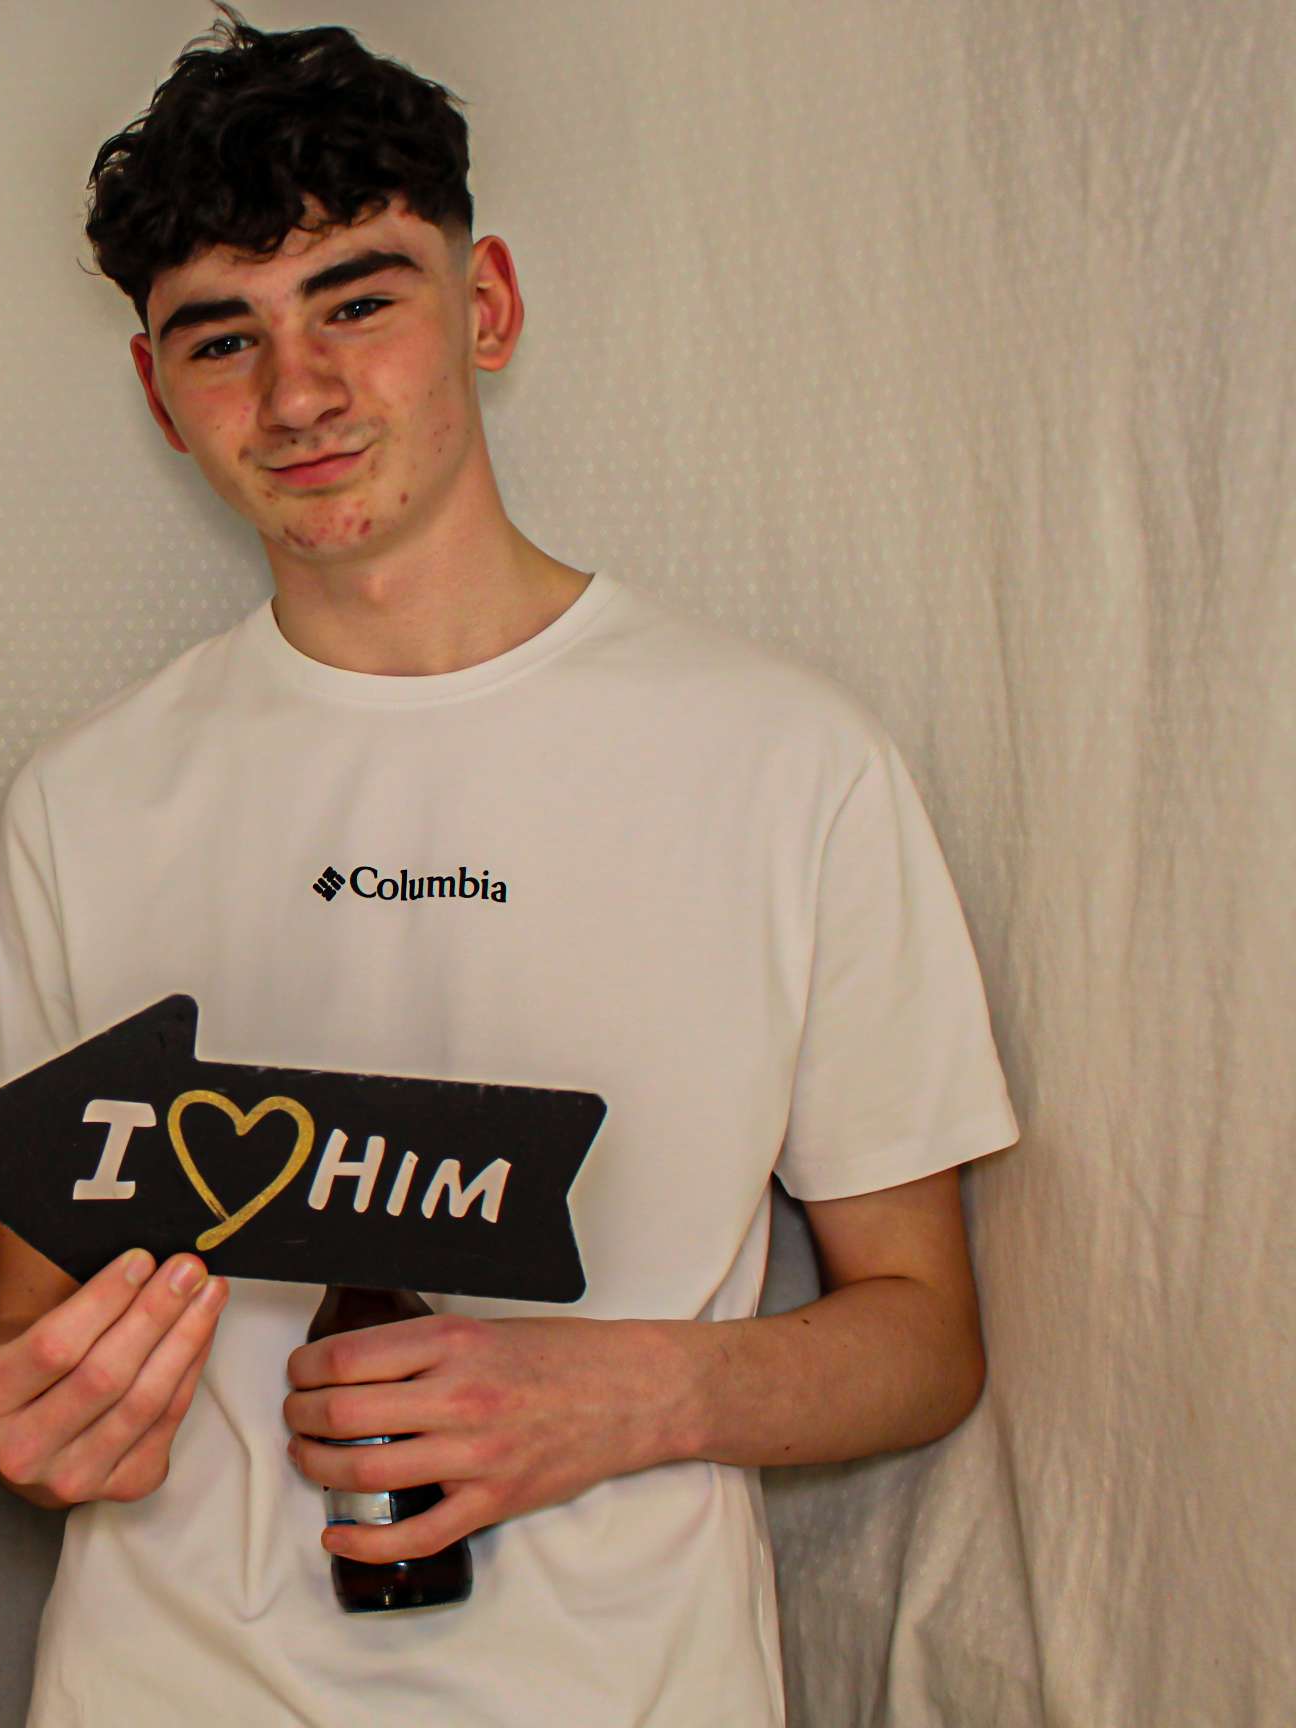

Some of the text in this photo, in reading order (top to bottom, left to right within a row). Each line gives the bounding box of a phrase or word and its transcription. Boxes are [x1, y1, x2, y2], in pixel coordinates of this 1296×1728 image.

[349, 865, 507, 903] Columbia
[72, 1098, 512, 1223] I HIM
